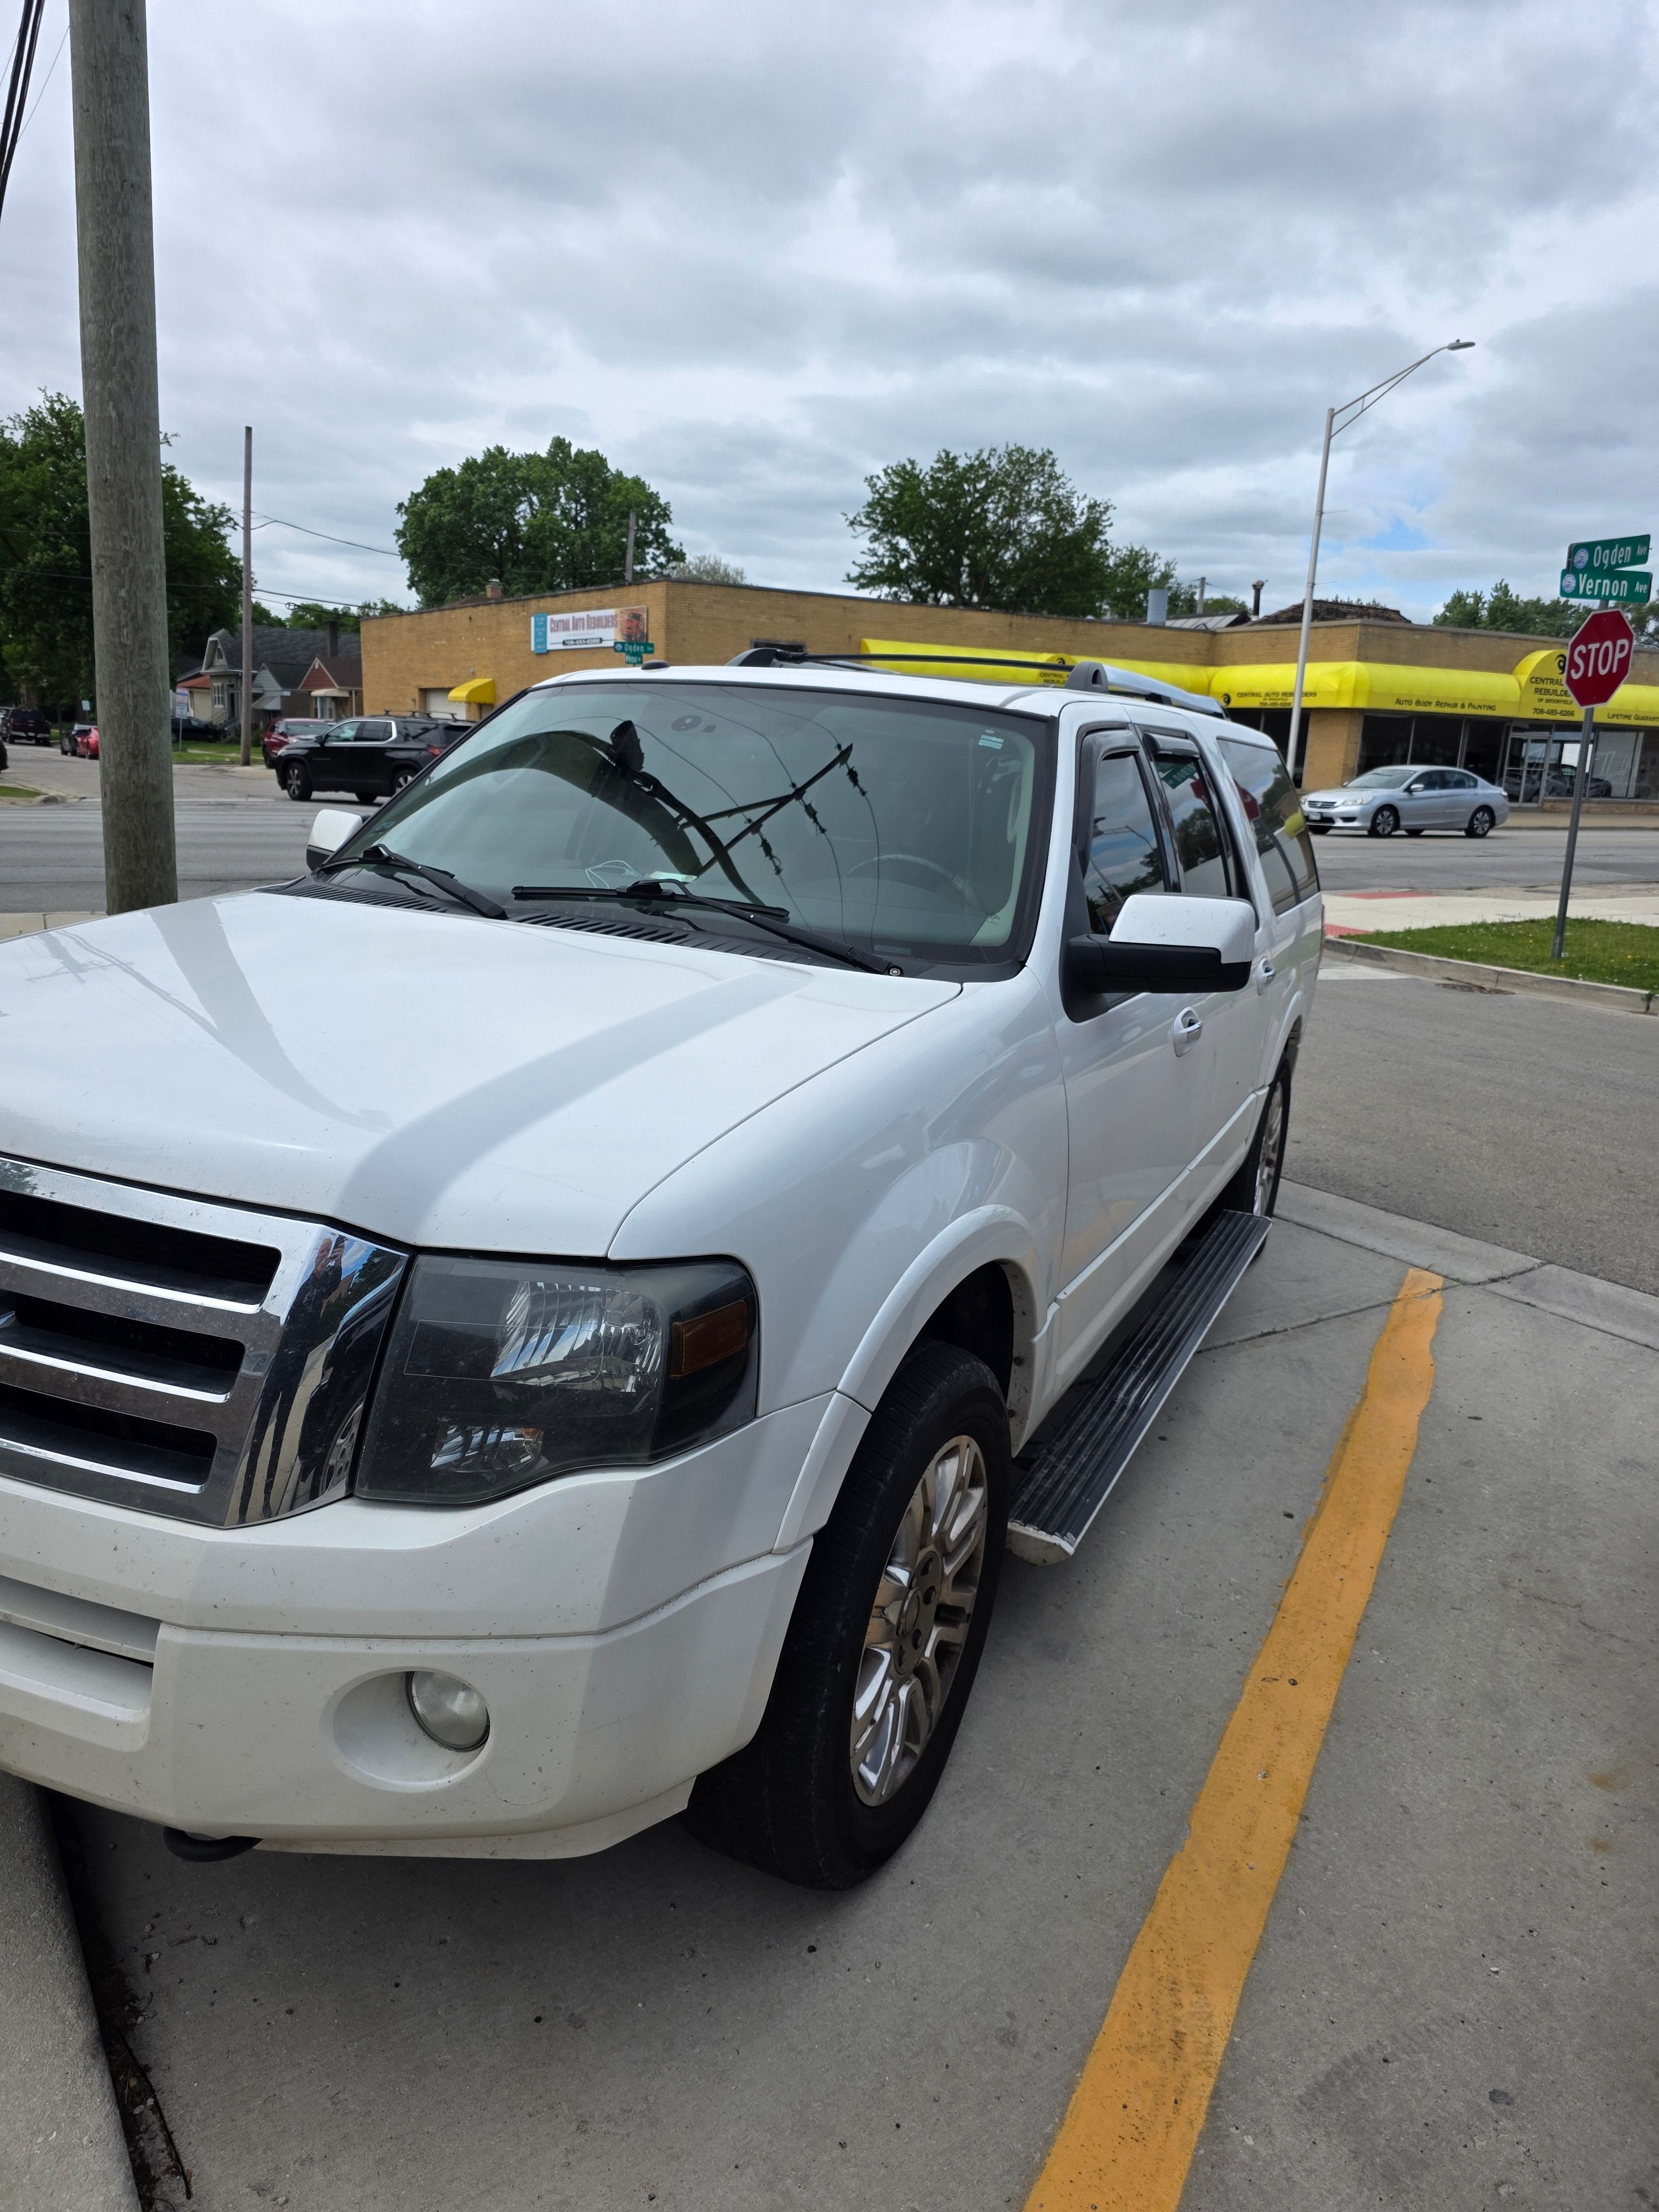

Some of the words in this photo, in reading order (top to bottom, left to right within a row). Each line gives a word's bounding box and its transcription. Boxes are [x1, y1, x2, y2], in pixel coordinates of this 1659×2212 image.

[1593, 544, 1631, 570] Ogden
[1636, 545, 1647, 556] Ave
[1579, 573, 1628, 597] Vernon
[1635, 581, 1647, 593] Ave
[624, 643, 644, 653] Ogden
[1571, 639, 1629, 680] STOP
[1530, 677, 1564, 686] CENTRAL
[1533, 687, 1571, 697] REBUILDE
[1395, 697, 1412, 706] AUTO
[1435, 701, 1458, 709] REPAIR
[1532, 708, 1574, 717] 708-485-6266
